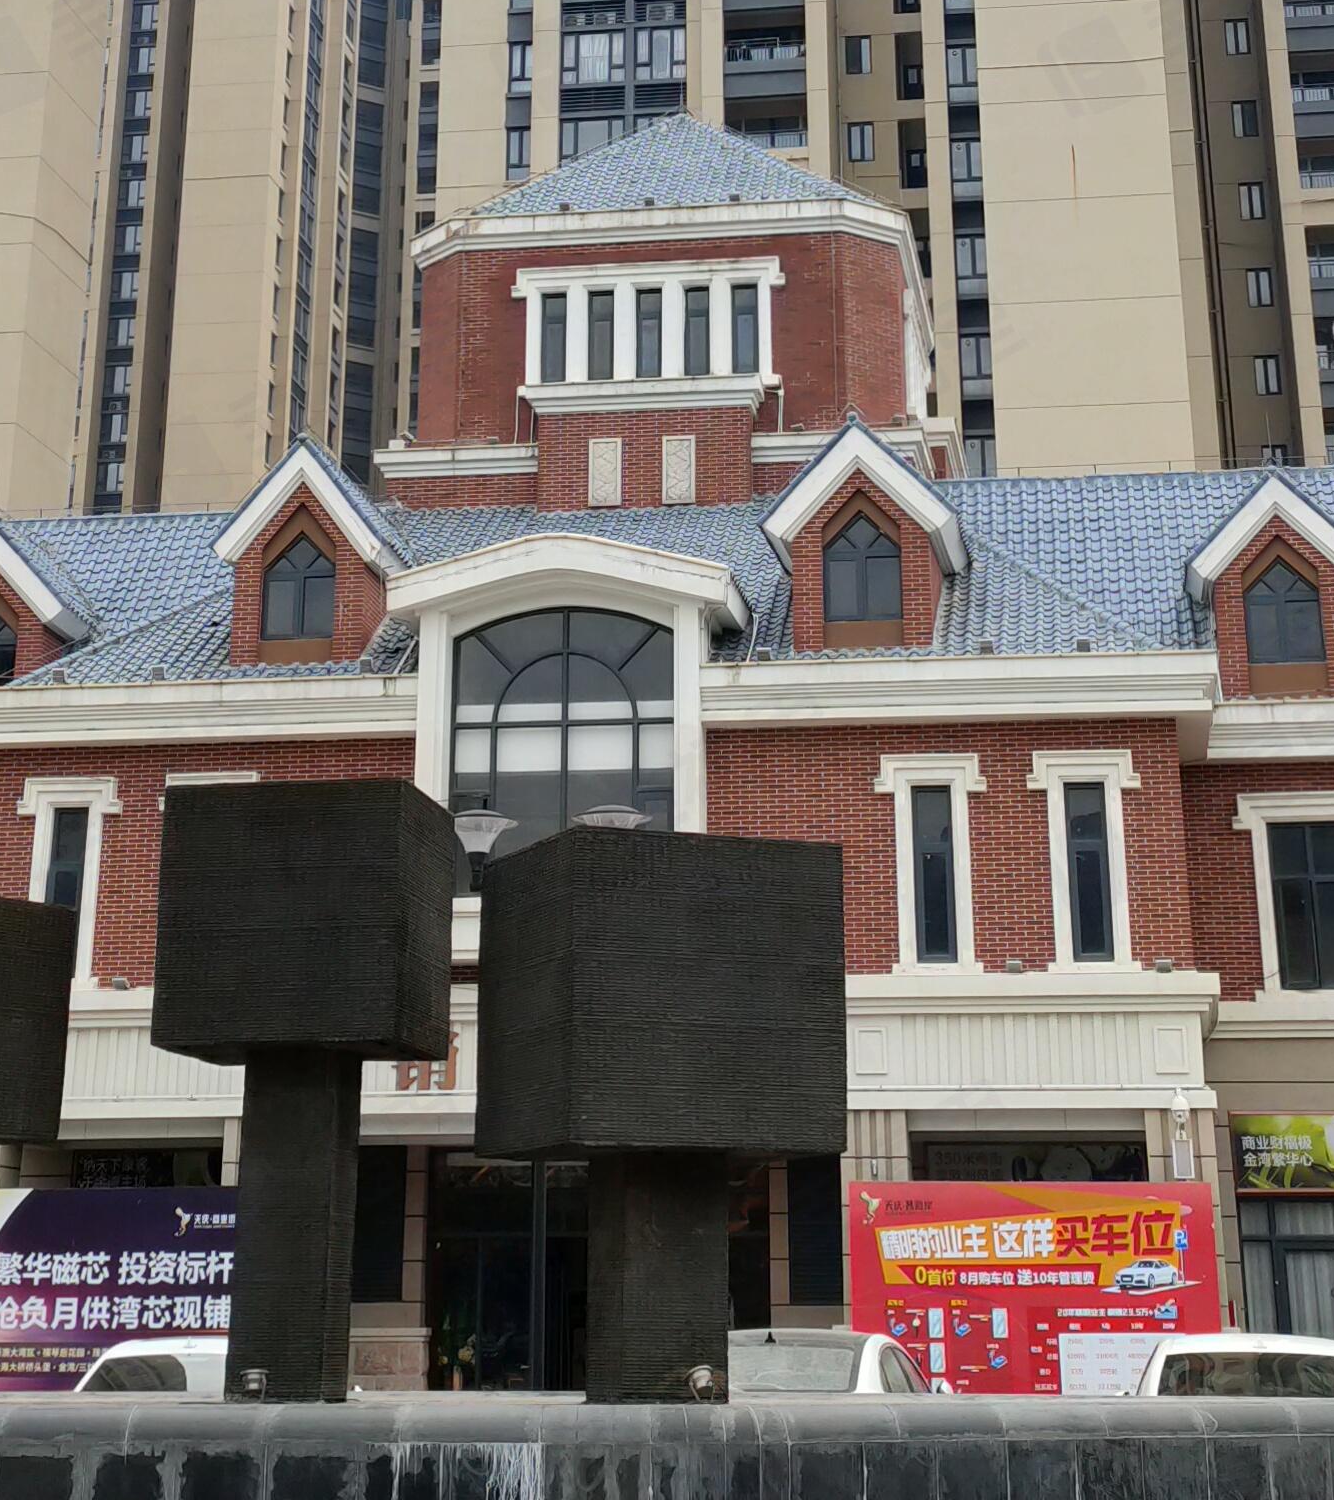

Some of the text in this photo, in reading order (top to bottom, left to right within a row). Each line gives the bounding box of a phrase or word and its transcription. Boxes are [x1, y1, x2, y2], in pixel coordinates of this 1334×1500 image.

[879, 1209, 1177, 1260] 精明的业主 这样买车位
[118, 1249, 233, 1285] 投资标杆
[915, 1266, 957, 1287] 0首付
[960, 1271, 1014, 1286] 8月购车位
